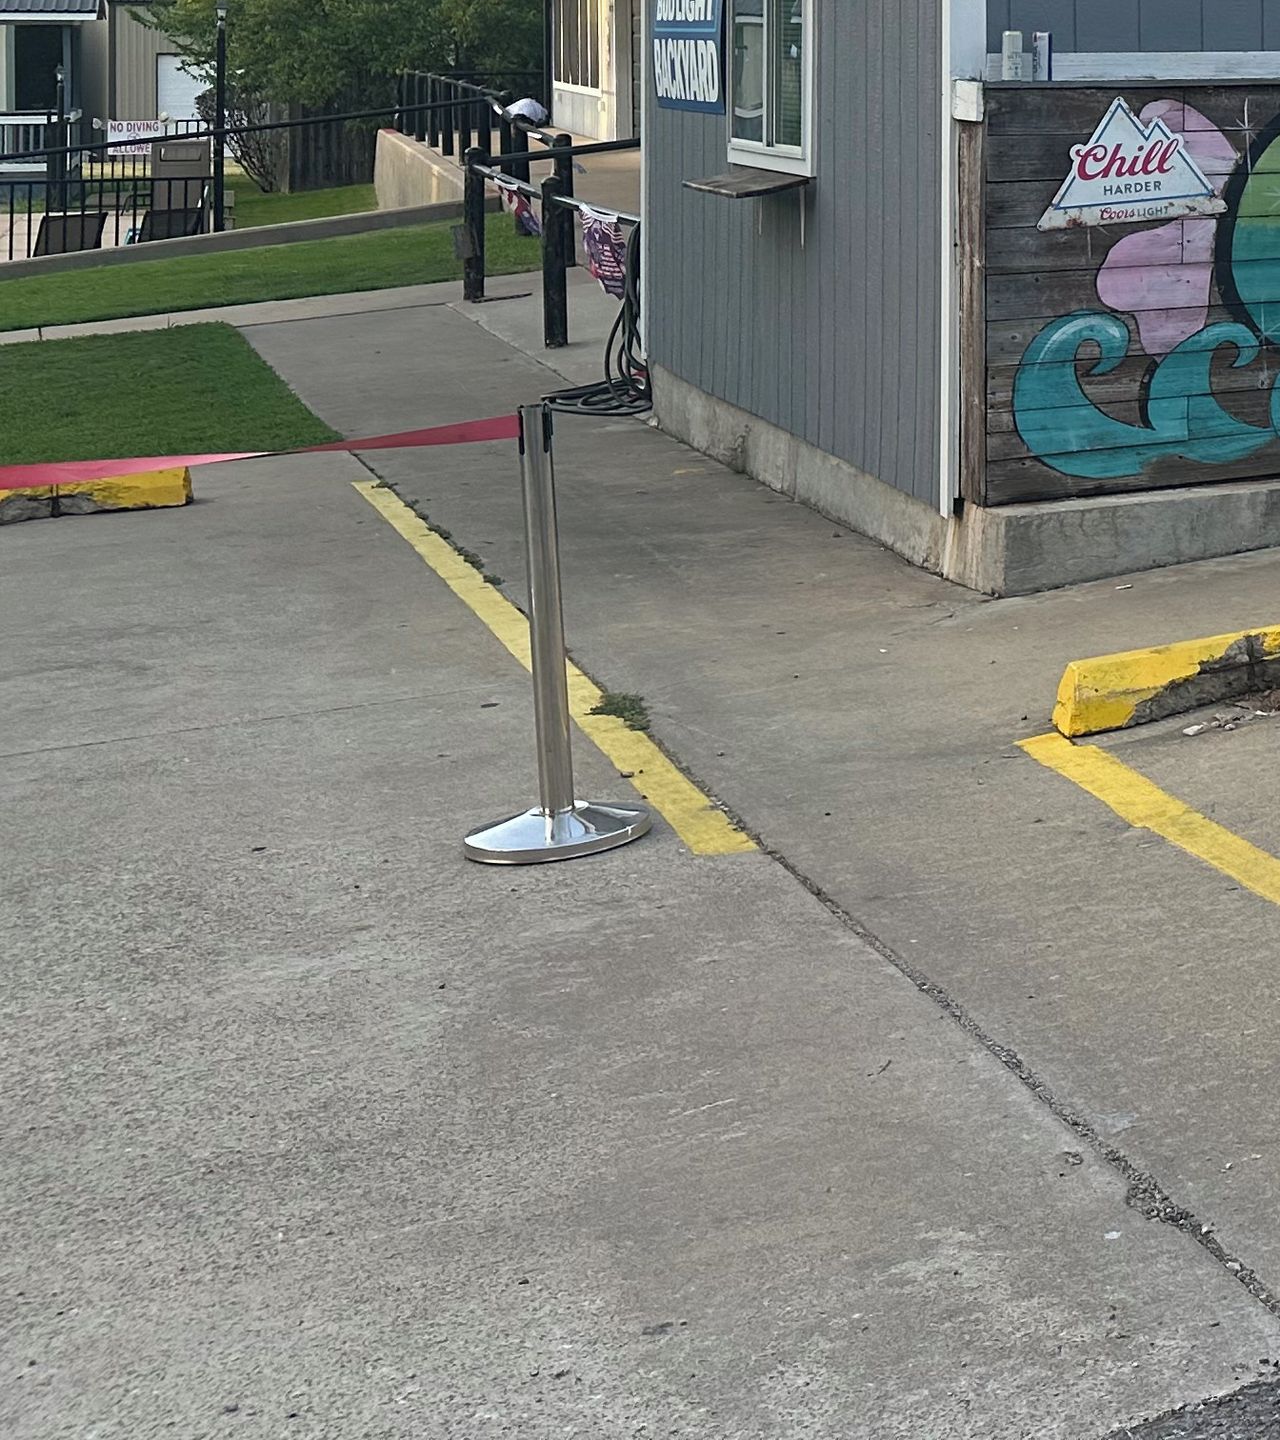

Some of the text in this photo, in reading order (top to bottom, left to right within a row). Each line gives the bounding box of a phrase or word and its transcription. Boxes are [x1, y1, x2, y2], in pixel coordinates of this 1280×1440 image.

[653, 38, 719, 102] BACKYARD
[110, 122, 159, 133] NO DIVING
[112, 143, 151, 153] ALLOWE
[1075, 138, 1179, 181] Chill
[1103, 180, 1162, 196] HARDER
[1100, 206, 1169, 220] Coors LIGHT
